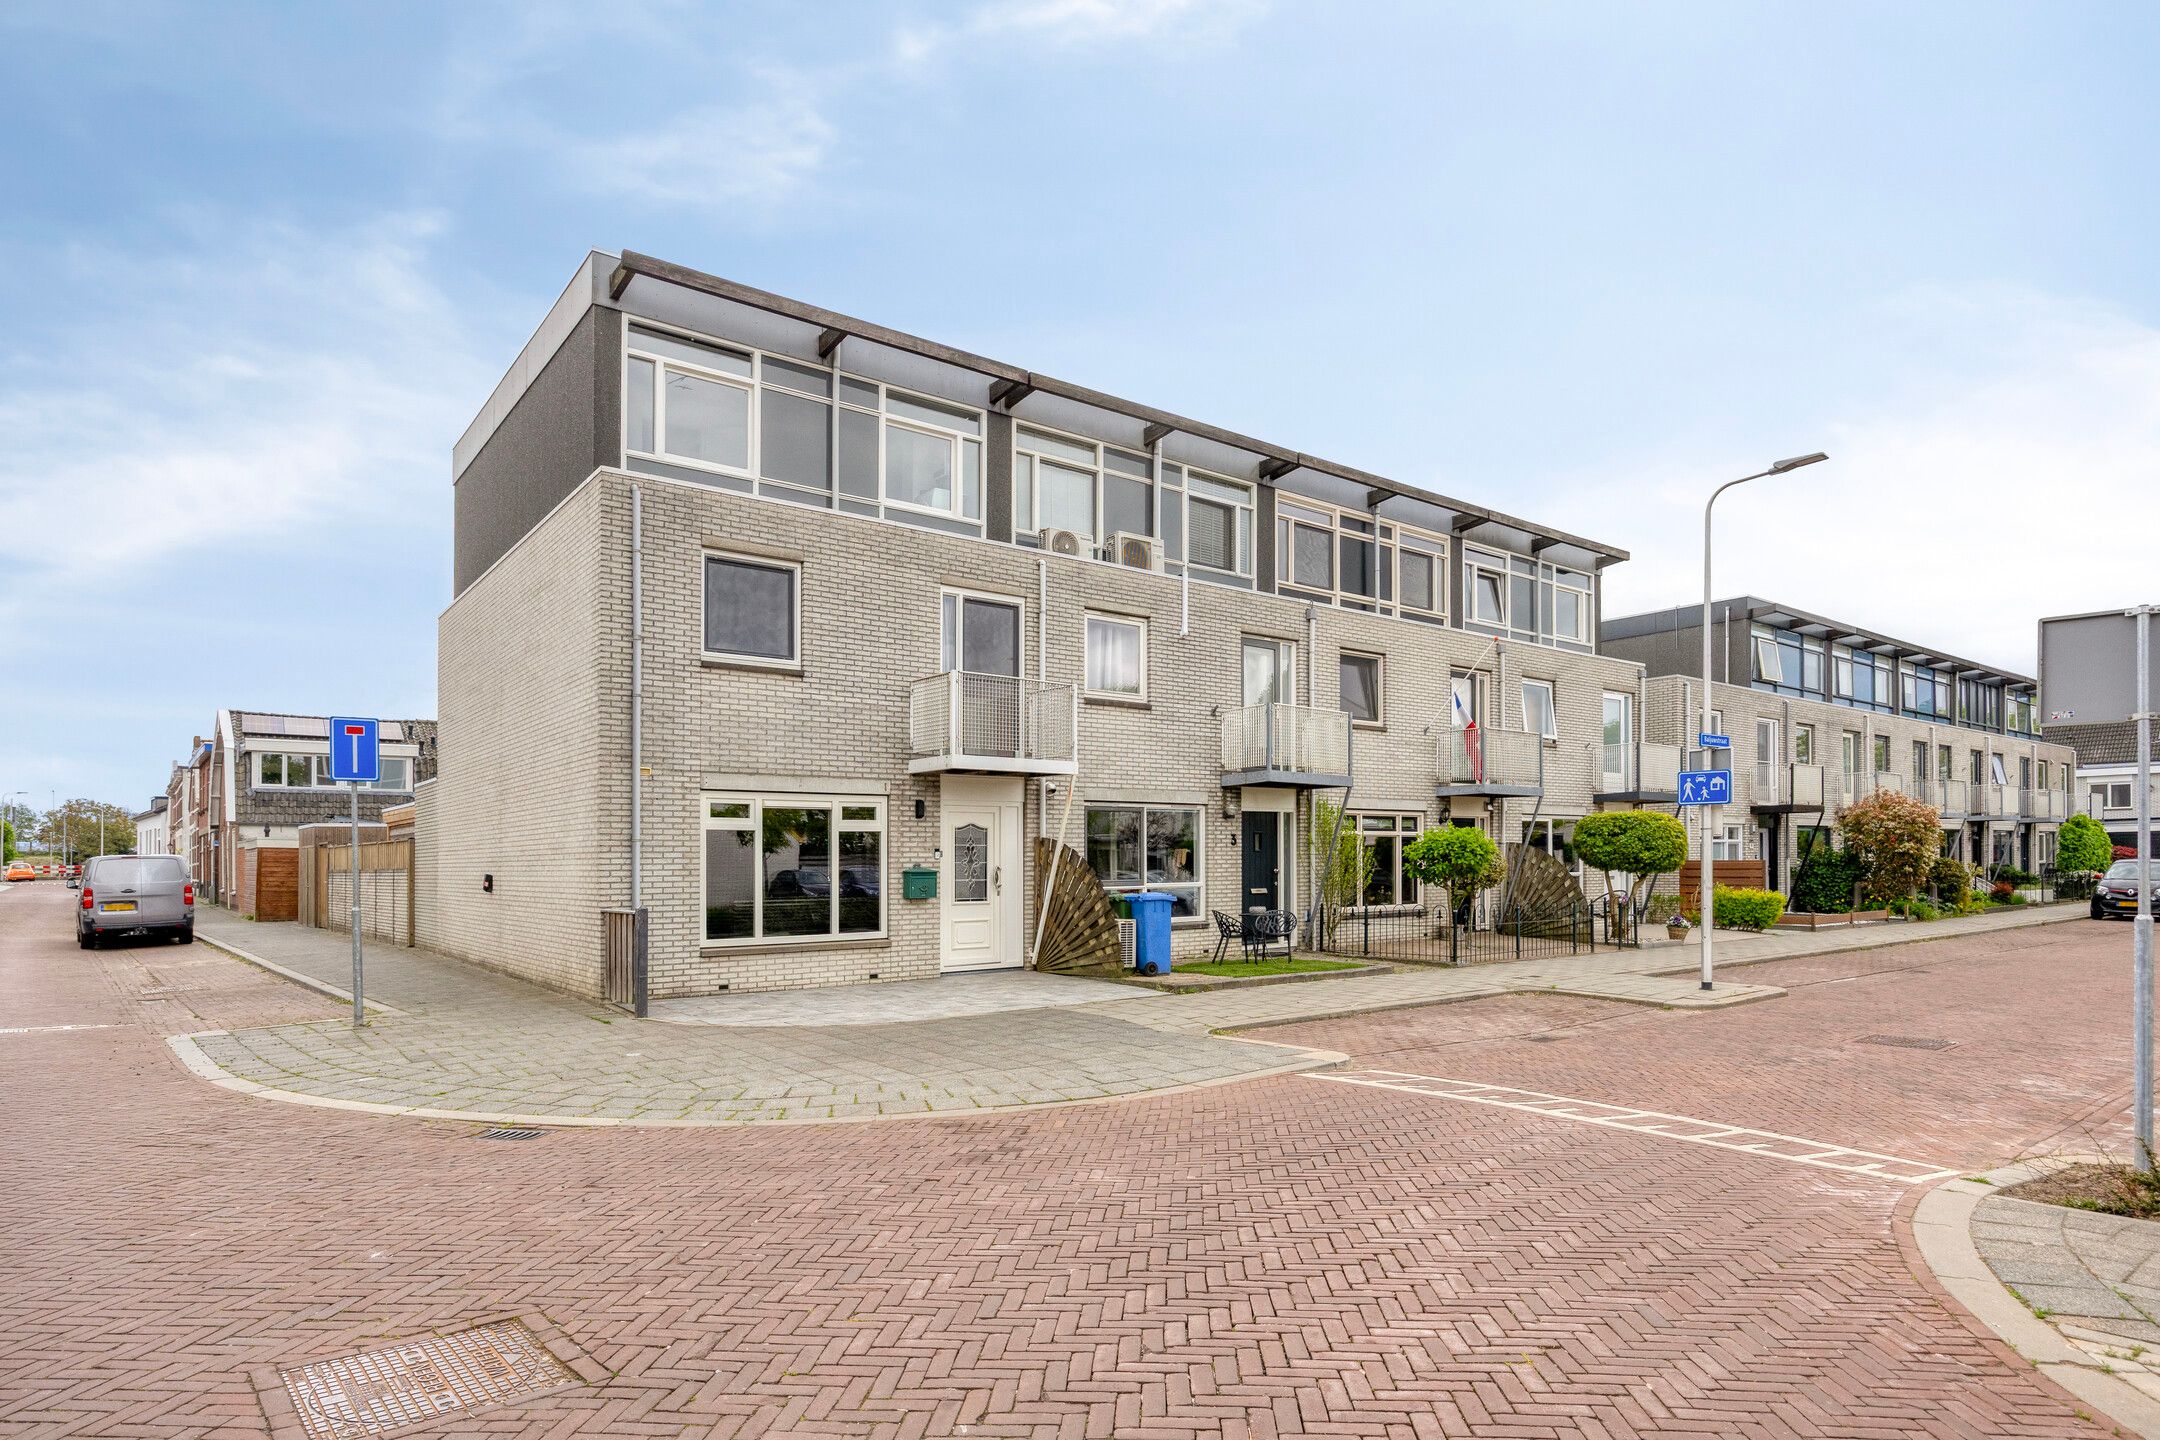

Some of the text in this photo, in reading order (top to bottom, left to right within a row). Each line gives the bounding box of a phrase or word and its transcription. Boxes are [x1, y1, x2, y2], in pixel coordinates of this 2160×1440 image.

[1231, 834, 1236, 845] 3
[412, 1361, 444, 1393] REGEN
[473, 1349, 509, 1377] WATER
